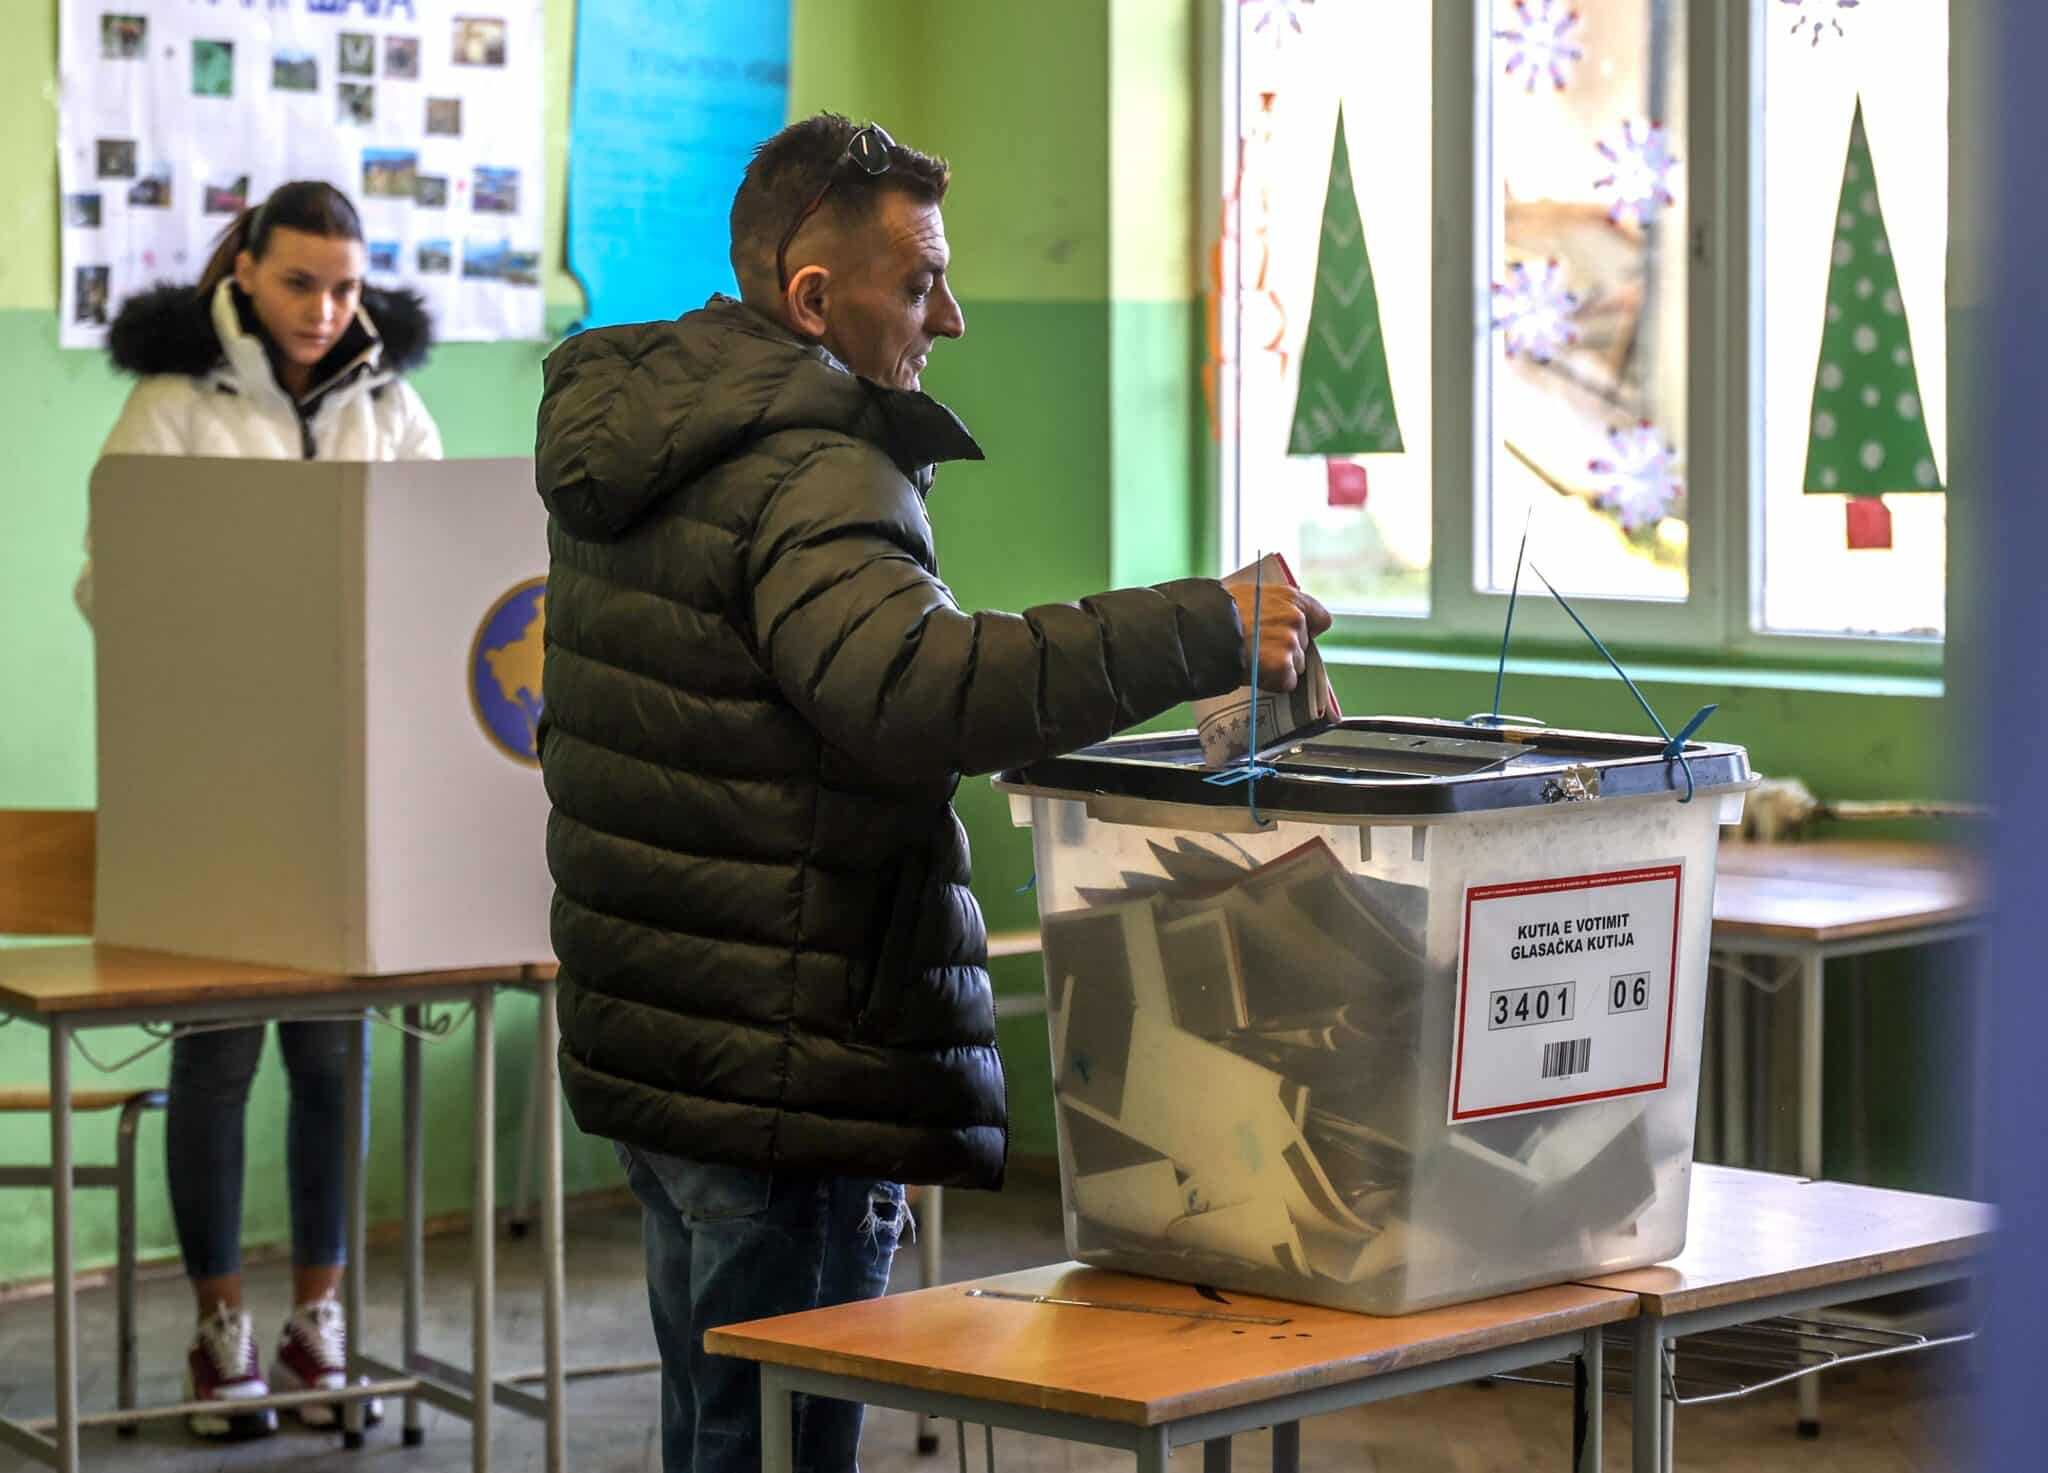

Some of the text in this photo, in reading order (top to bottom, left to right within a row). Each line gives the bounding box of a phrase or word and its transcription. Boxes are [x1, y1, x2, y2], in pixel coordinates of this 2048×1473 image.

[1518, 913, 1630, 940] KUTIA E VOTIMIT
[1511, 932, 1634, 960] GLASAČKA KUTIJA
[1494, 977, 1646, 1025] 3401 06
